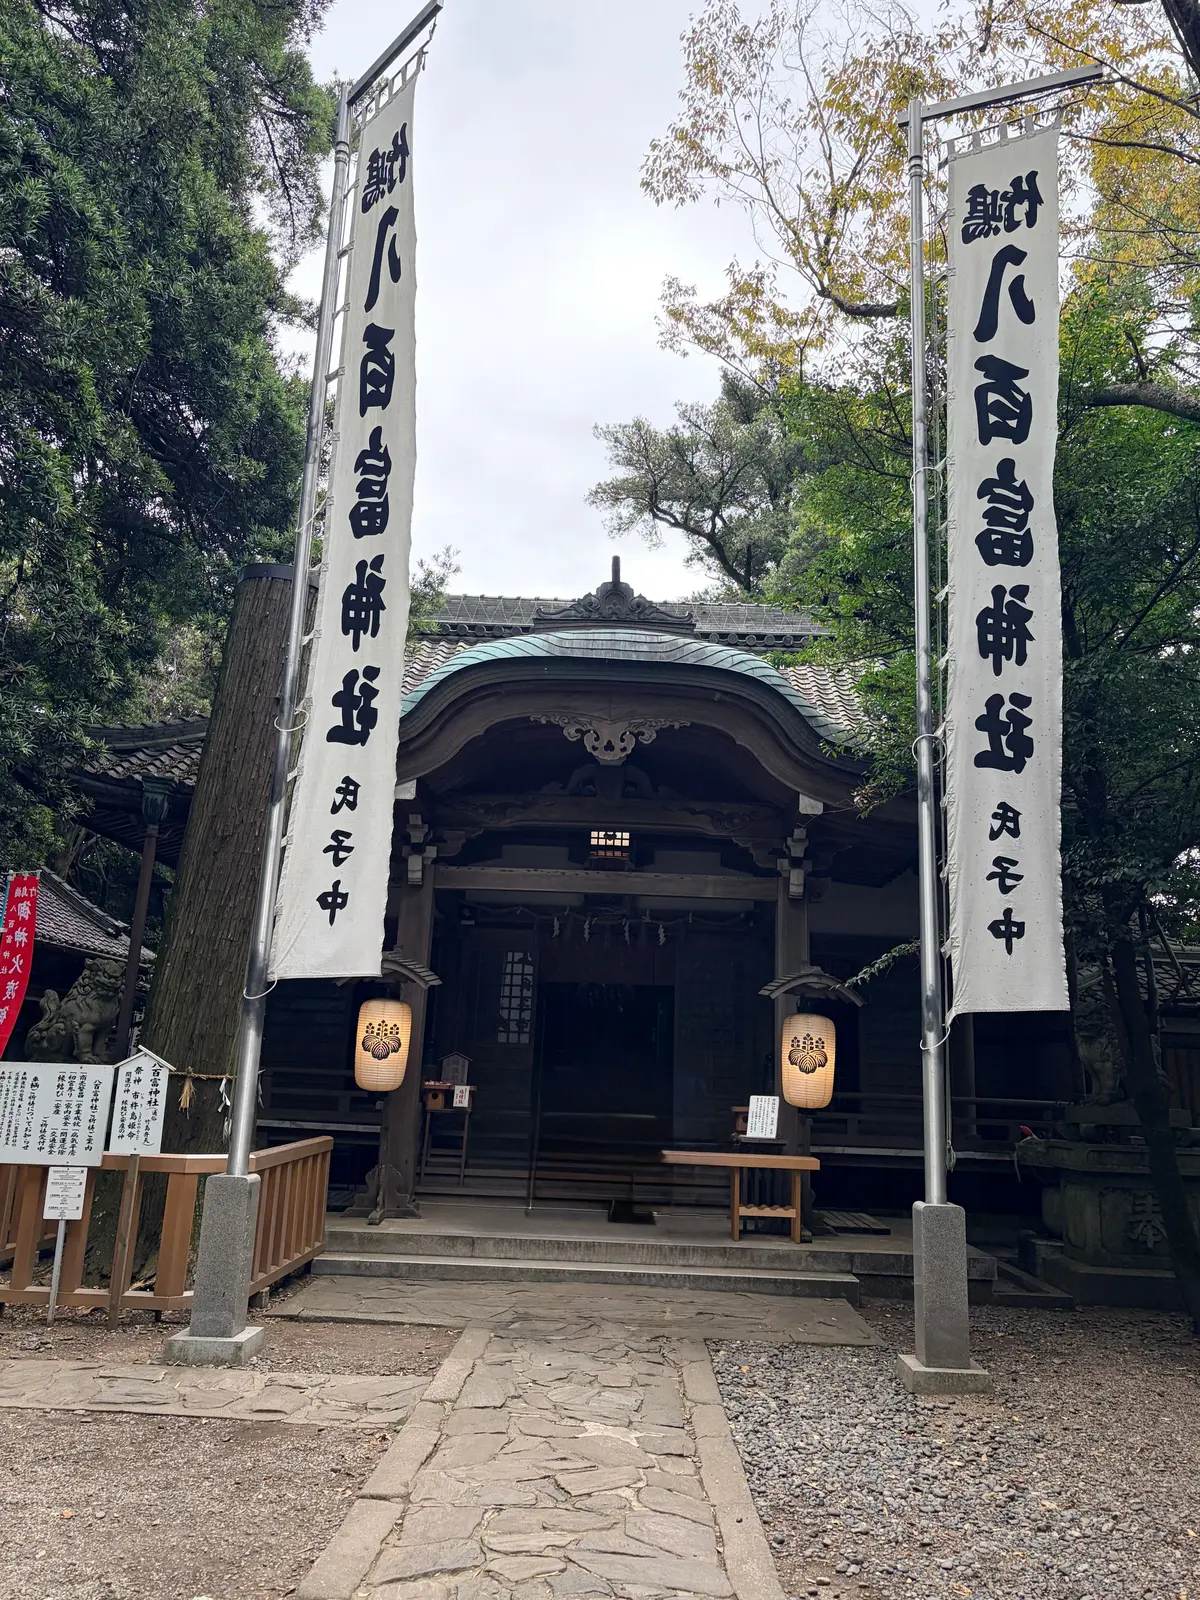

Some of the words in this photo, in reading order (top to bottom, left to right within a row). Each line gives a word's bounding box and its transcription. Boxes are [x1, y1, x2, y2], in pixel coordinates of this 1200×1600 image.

[146, 1062, 164, 1107] 八百富神社
